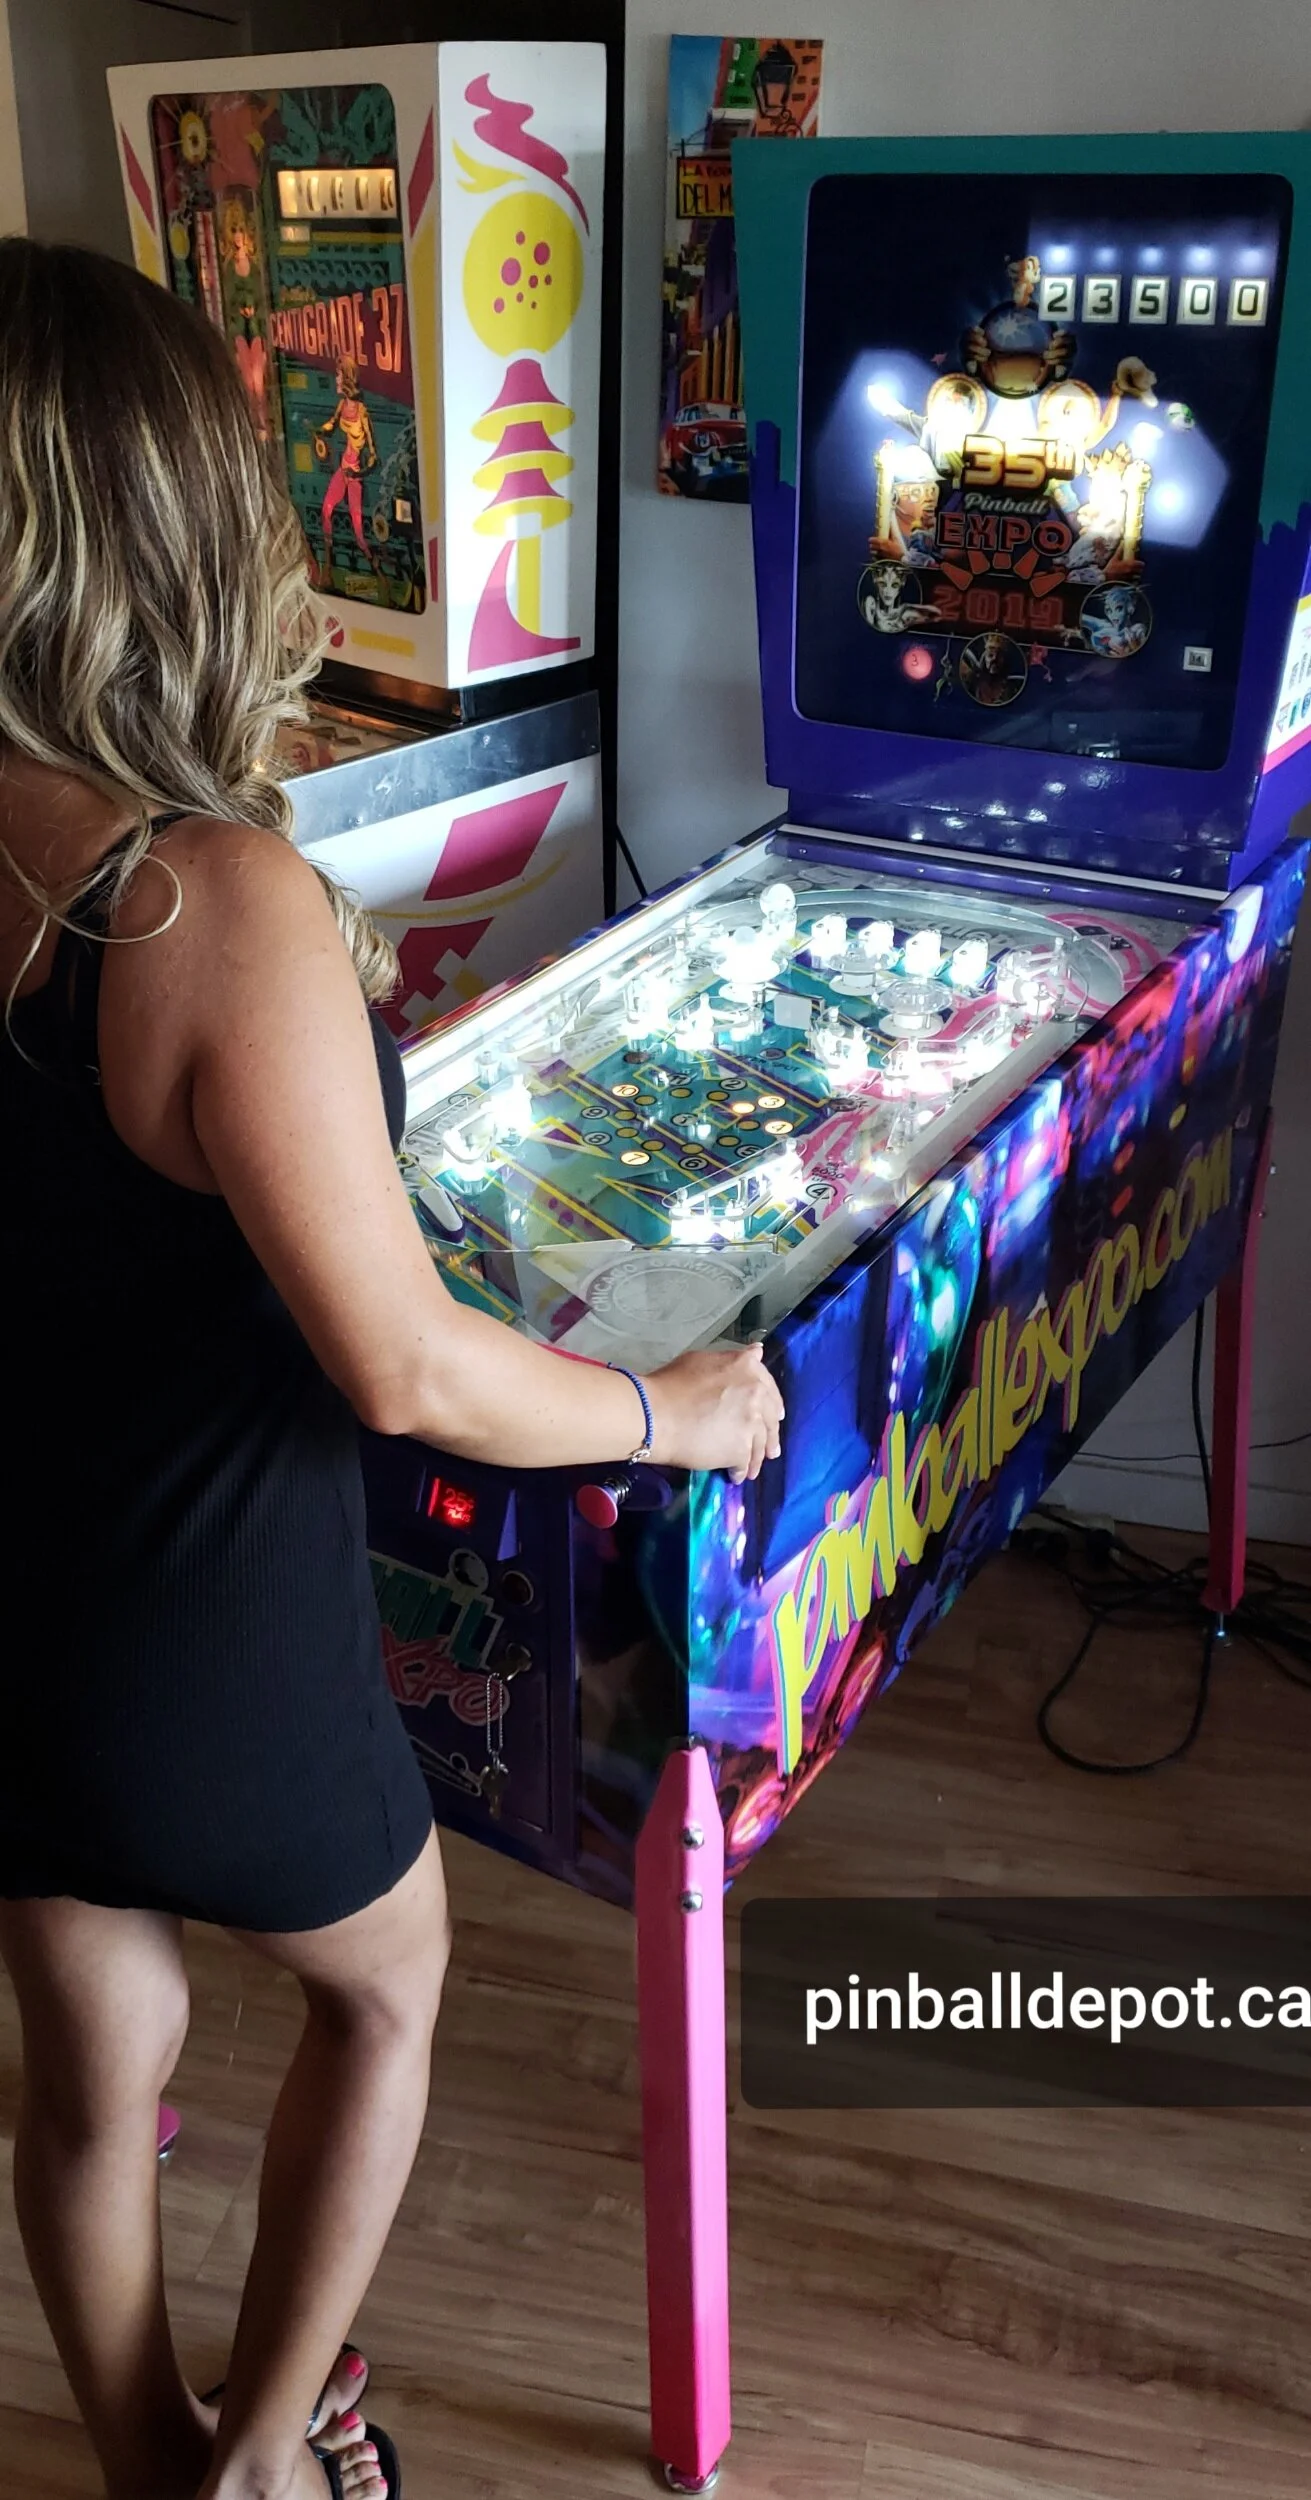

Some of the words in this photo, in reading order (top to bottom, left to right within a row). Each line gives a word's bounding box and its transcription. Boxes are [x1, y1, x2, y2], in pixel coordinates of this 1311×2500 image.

[682, 183, 715, 214] DEL
[270, 292, 368, 366] CENTIGRADE
[372, 283, 403, 373] 37
[963, 492, 1048, 515] Pinball
[937, 512, 1073, 557] EXPO
[932, 585, 1064, 629] 2019
[590, 1263, 638, 1313] CHICAGO
[649, 1256, 733, 1285] GAMING
[770, 1127, 1234, 1776] pinballexpo.com
